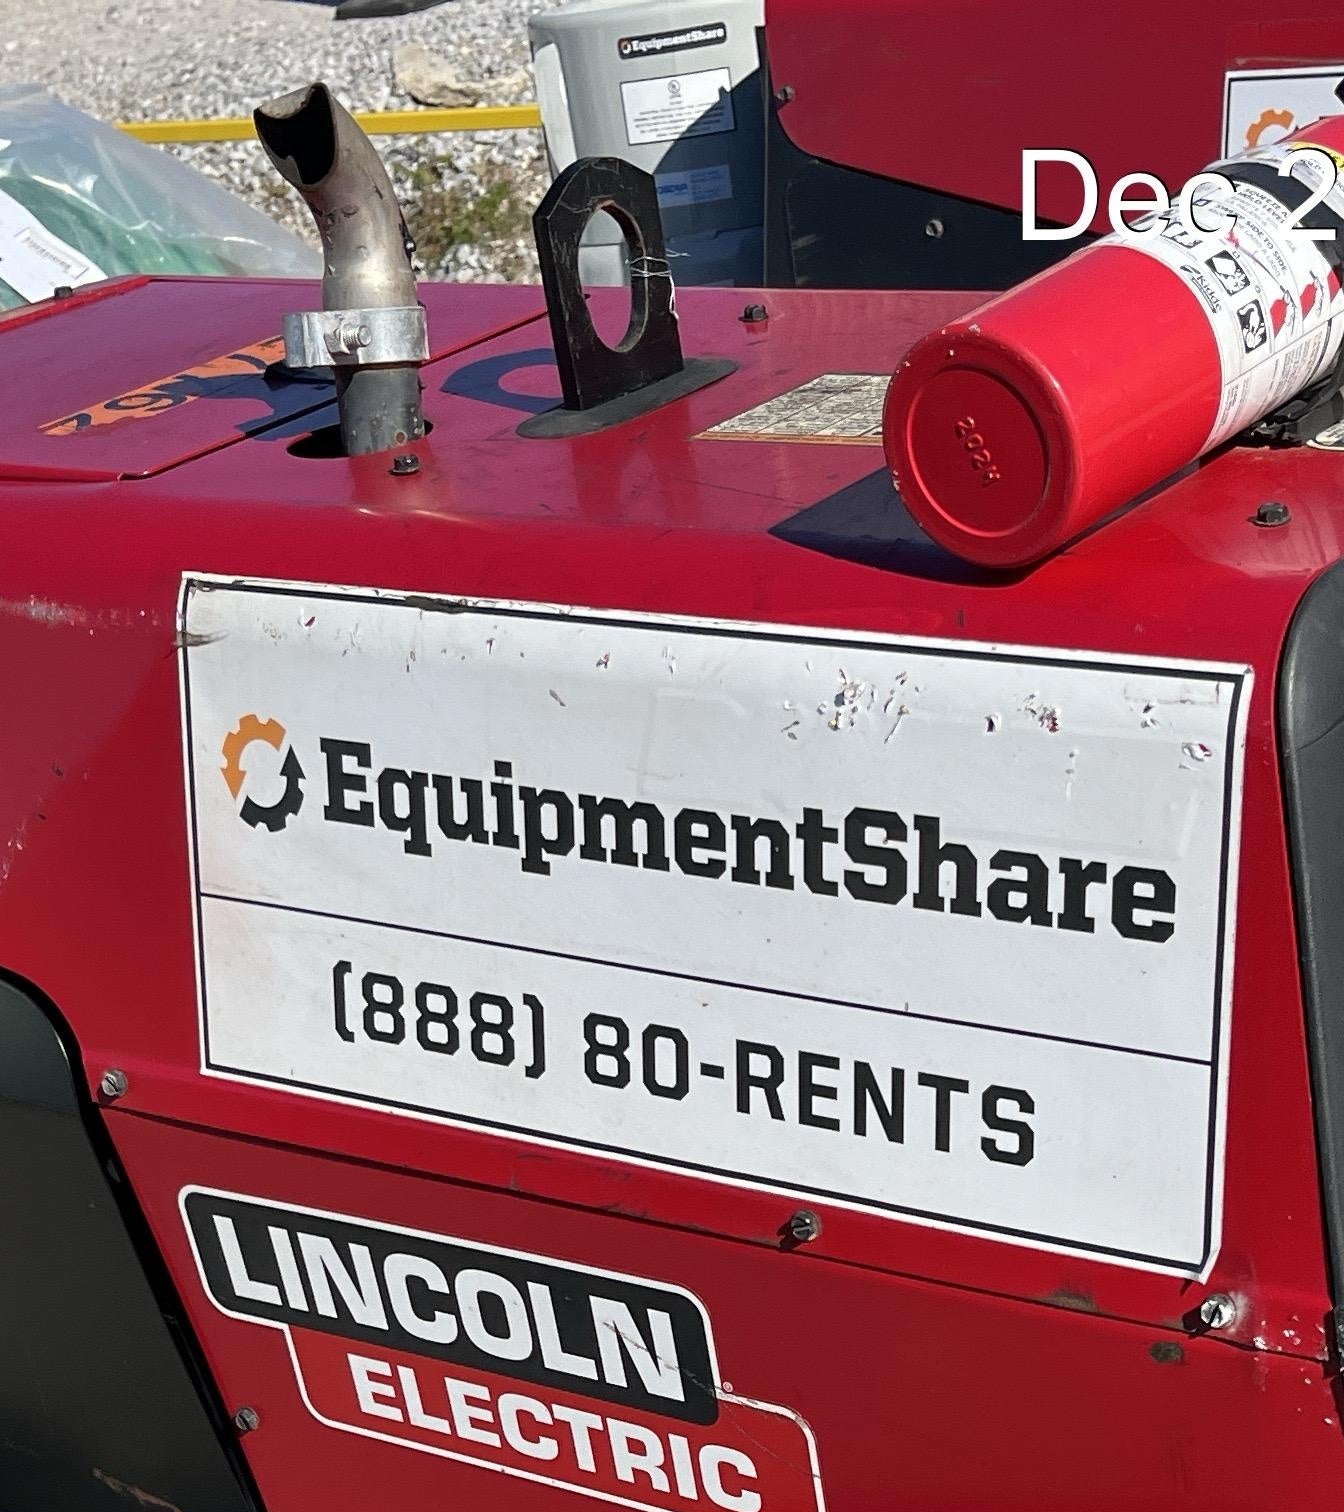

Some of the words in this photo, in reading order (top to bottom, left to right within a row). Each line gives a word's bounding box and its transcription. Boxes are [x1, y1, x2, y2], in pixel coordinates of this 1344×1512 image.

[631, 28, 724, 51] EquipmentShare
[1197, 273, 1221, 312] Kidde
[320, 737, 1178, 944] EquipmentShare
[332, 960, 544, 1078] (888)
[582, 1013, 1036, 1168] 80-RENTS
[211, 1213, 686, 1402] LINCOLN
